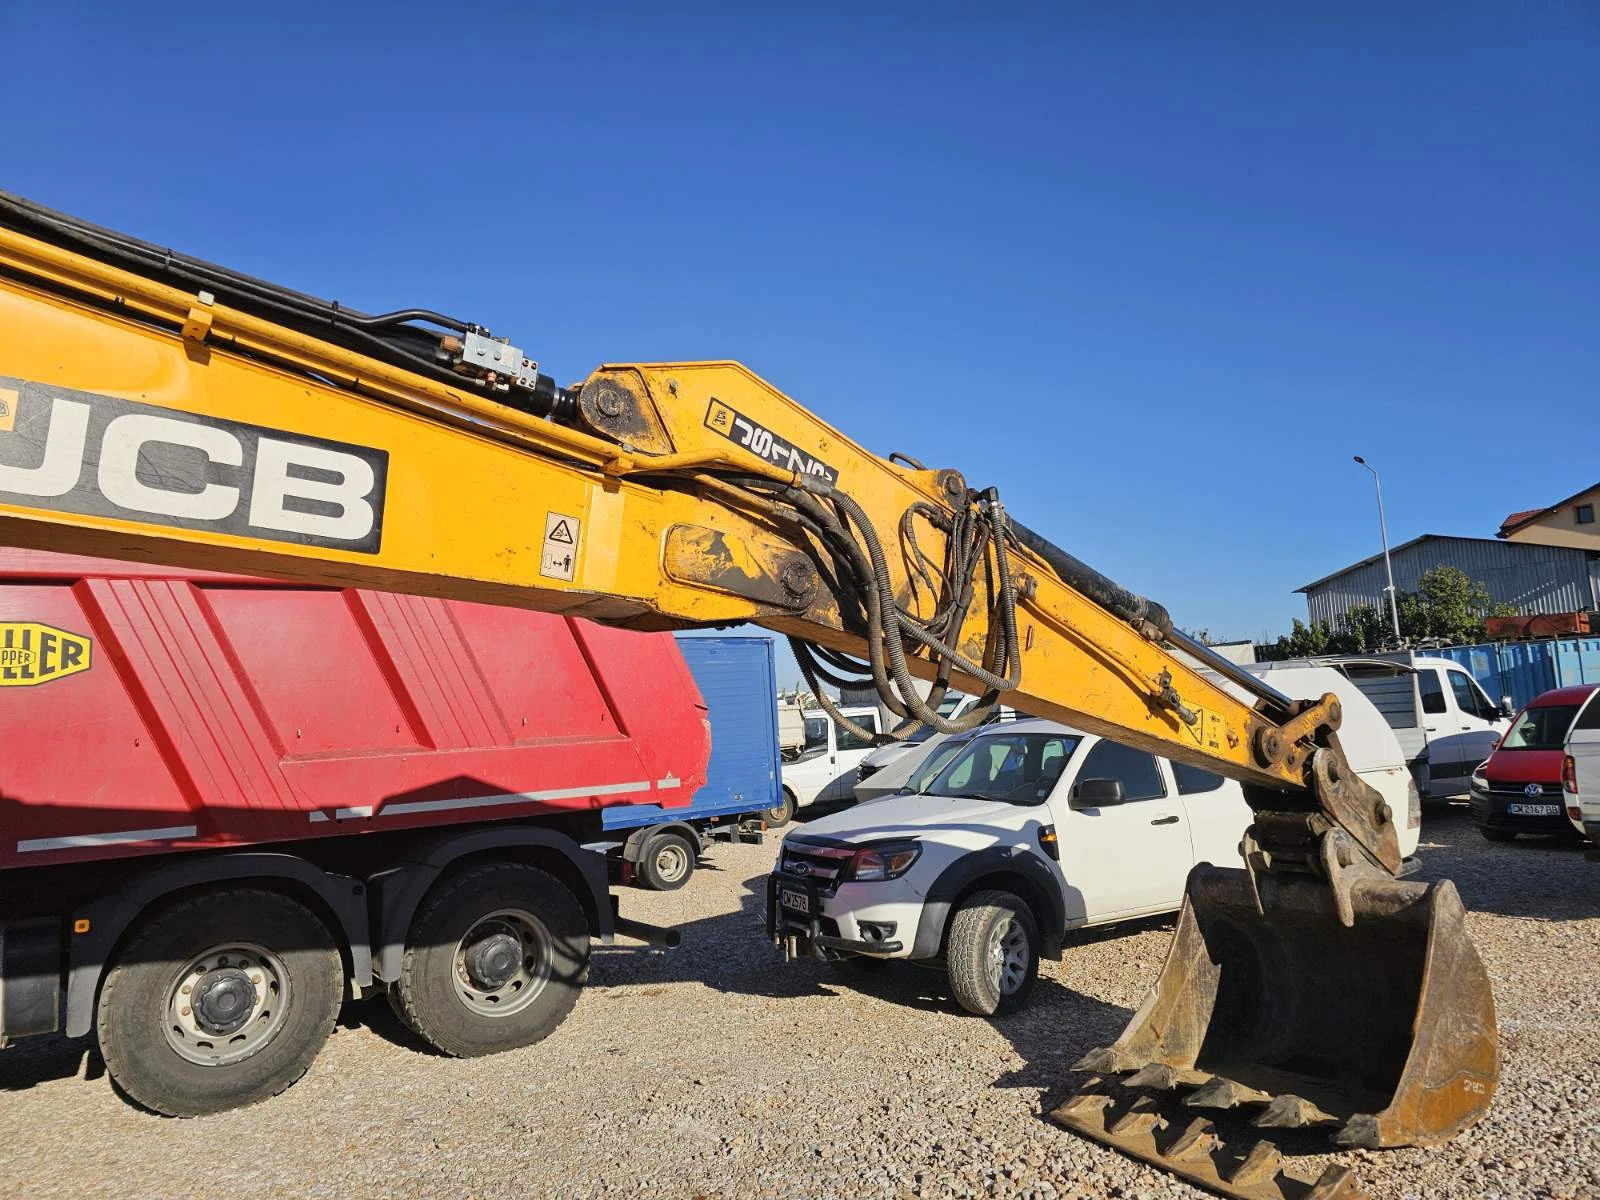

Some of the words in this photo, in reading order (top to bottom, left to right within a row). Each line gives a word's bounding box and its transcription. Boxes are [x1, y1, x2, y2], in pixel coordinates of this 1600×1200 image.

[0, 398, 374, 541] JCB
[1, 650, 31, 665] PPER
[3, 629, 83, 679] LLER
